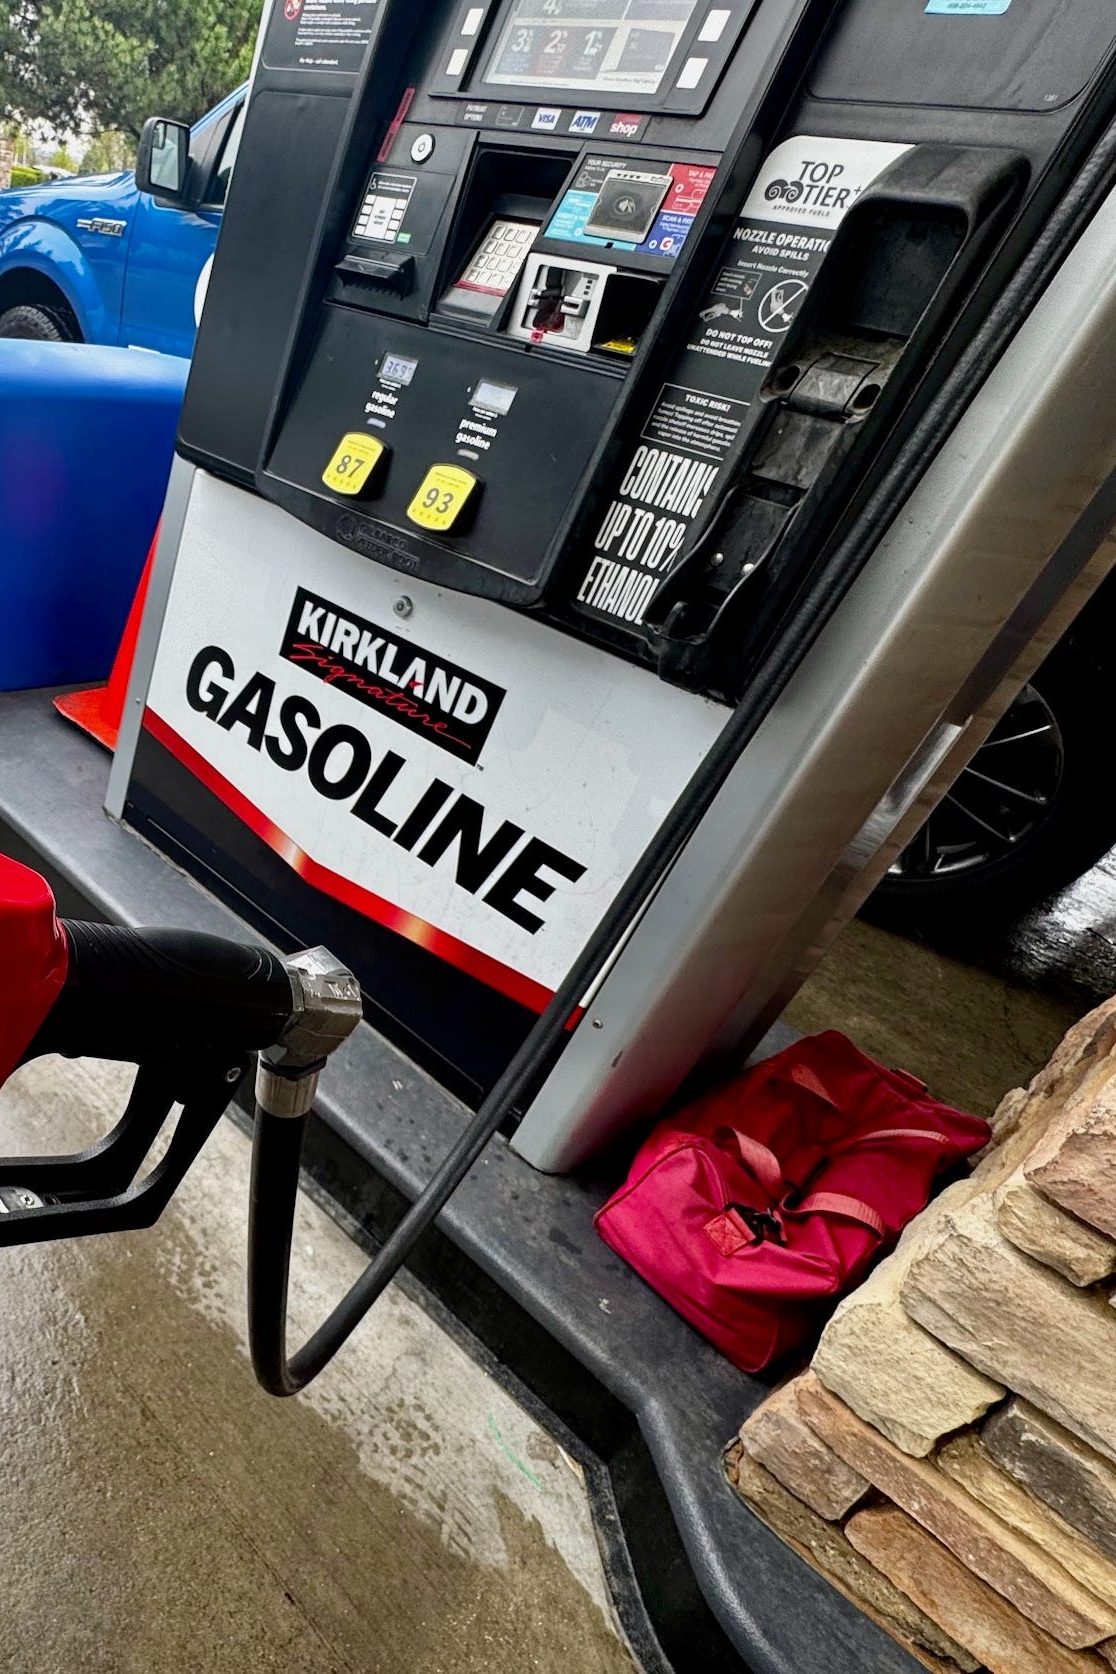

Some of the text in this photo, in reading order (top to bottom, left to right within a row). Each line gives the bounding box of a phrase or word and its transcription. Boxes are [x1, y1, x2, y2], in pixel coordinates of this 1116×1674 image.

[538, 114, 555, 124] VISA
[572, 115, 598, 129] ATM
[610, 122, 638, 137] shop
[798, 160, 845, 184] TOP
[733, 227, 778, 245] NOZZLE
[751, 245, 810, 262] AVOID SPILLS
[705, 328, 719, 338] DO
[718, 331, 738, 341] NOT
[736, 334, 754, 345] TOP
[371, 390, 399, 406] regular
[685, 394, 731, 412] TOXIC RISK!
[364, 402, 396, 419] gasoline
[458, 418, 498, 438] premium
[455, 432, 491, 450] gasoline
[336, 455, 365, 478] 87
[422, 487, 454, 514] 93
[594, 500, 633, 552] UP
[617, 507, 655, 561] TO
[576, 555, 661, 626] ETHANOL
[297, 599, 488, 726] KIRKLAND
[289, 642, 473, 750] Signature
[186, 645, 588, 936] GASOLINE
